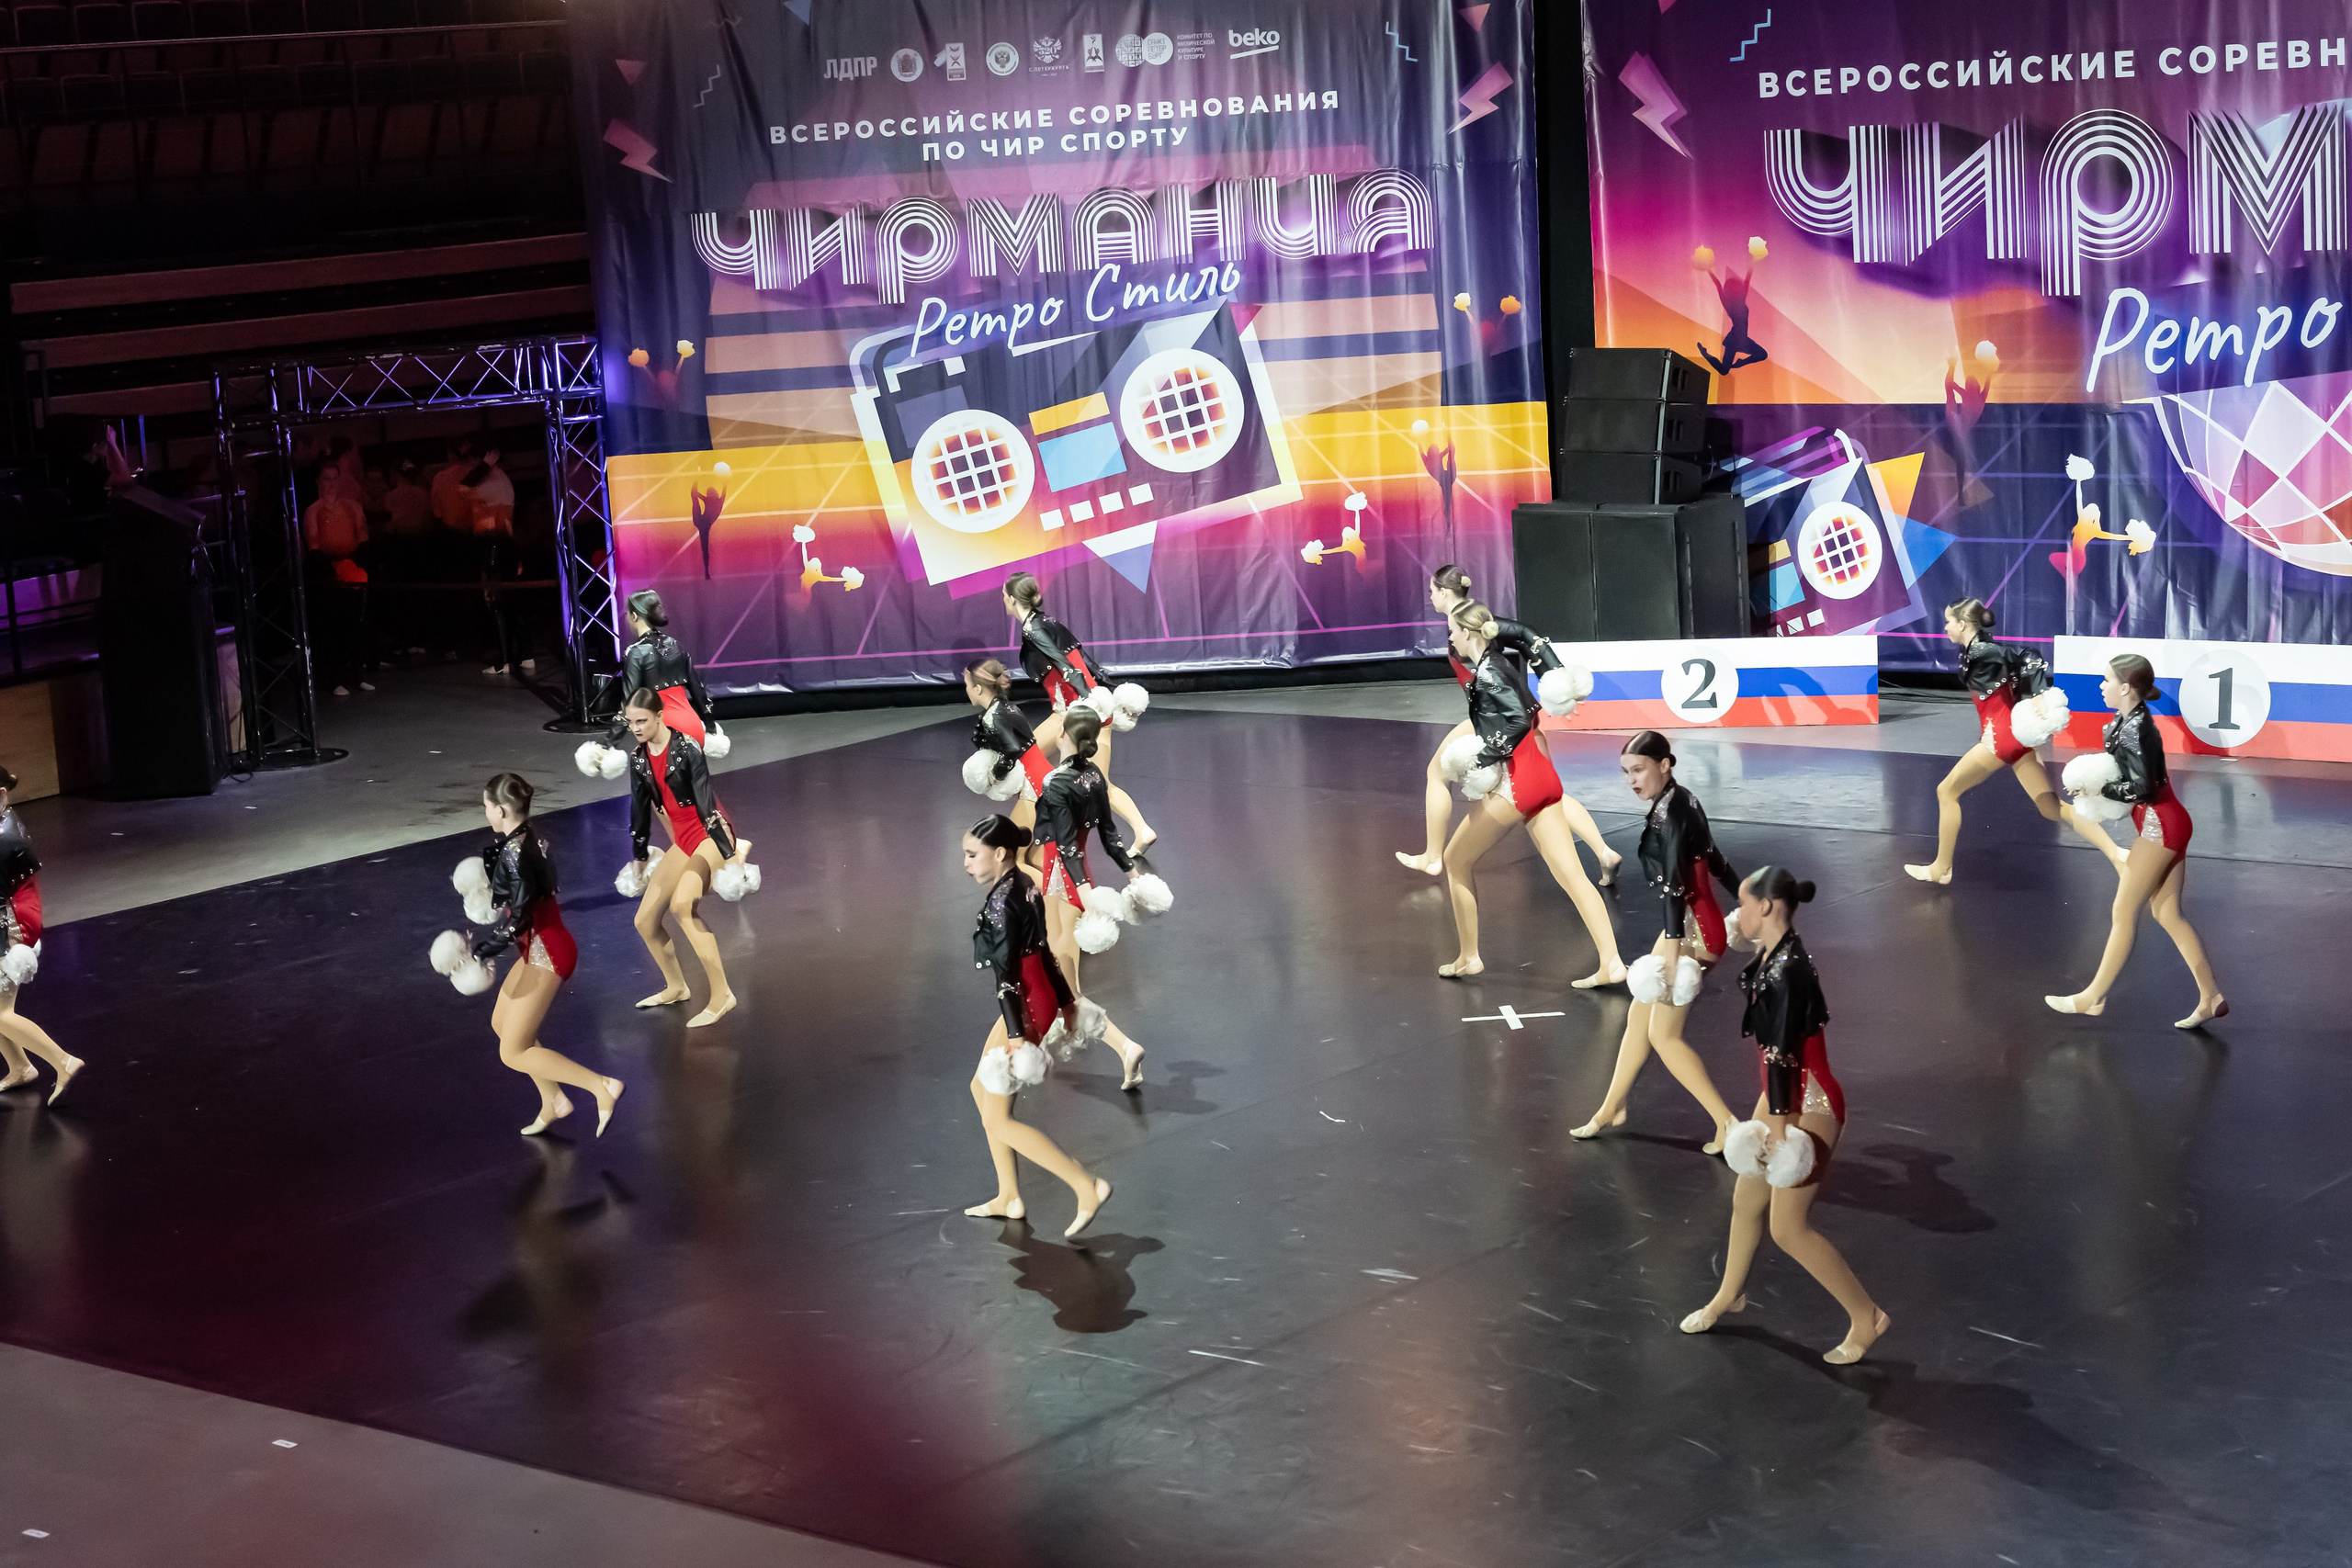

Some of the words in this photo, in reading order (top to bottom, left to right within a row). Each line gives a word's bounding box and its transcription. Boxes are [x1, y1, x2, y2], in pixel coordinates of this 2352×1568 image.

[1177, 39, 1216, 47] ФИЗИЧЕСКОЙ
[1228, 28, 1280, 47] beko
[823, 56, 878, 82] ЛДПР
[1758, 50, 2136, 98] ВСЕРОССИЙСКИЕ
[2159, 38, 2346, 76] СОРЕВН
[770, 108, 1053, 144] ВСЕРОССИЙСКИЕ
[1069, 90, 1339, 125] СОРЕВНОВАНИЯ
[922, 141, 966, 162] ПО
[980, 136, 1045, 157] ЧИР
[1060, 126, 1188, 152] СПОРТУ
[910, 296, 1064, 358] Ретро
[1086, 262, 1241, 322] Стиль
[2086, 287, 2342, 393] Ретро
[1680, 658, 1719, 710] 2
[2207, 667, 2241, 730] 1
